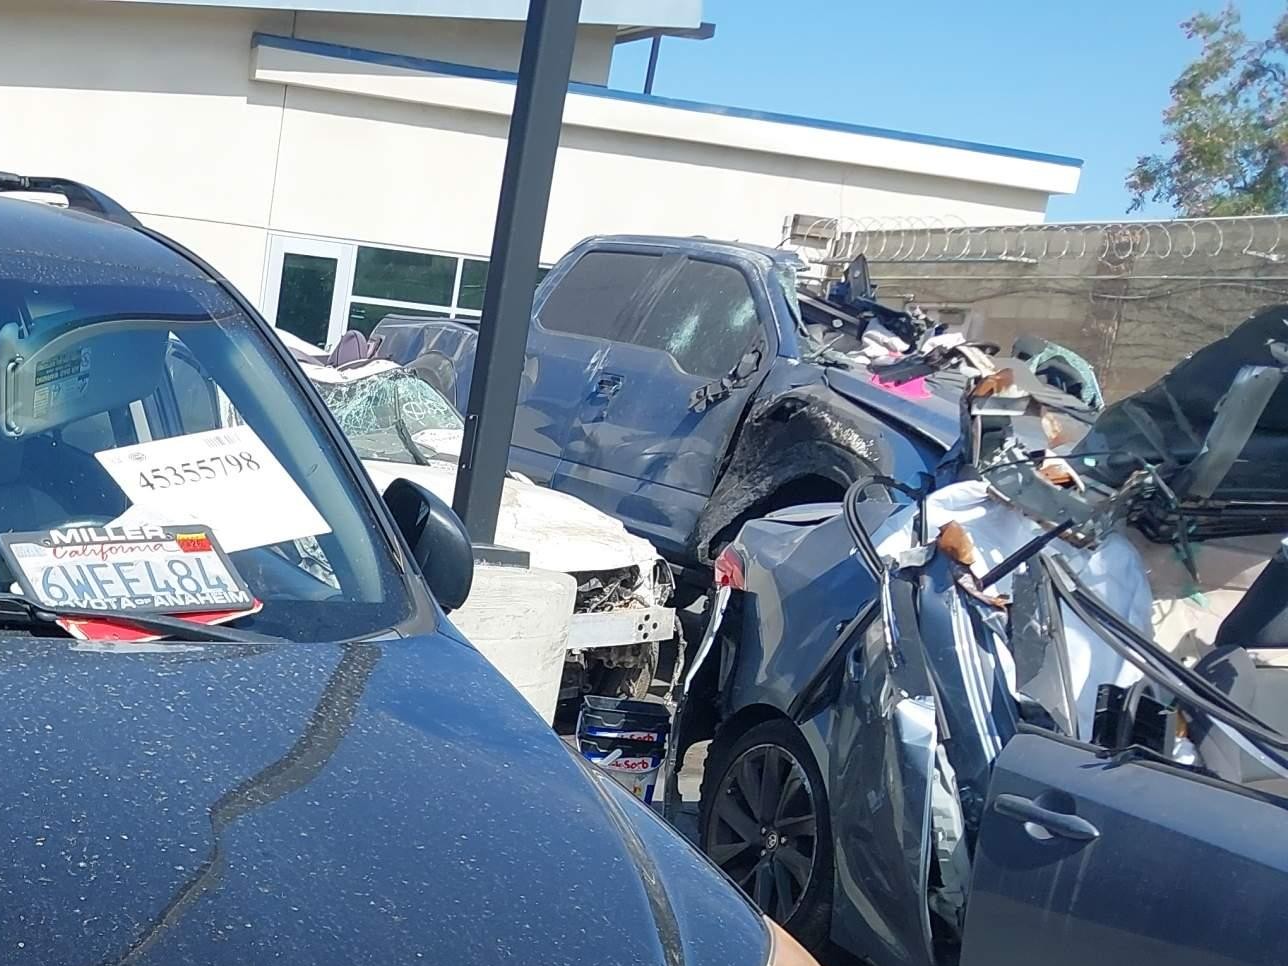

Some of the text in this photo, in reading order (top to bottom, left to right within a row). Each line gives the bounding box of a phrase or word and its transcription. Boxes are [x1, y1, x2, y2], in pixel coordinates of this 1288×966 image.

[139, 451, 261, 490] 45355798
[49, 526, 167, 545] MILLER
[52, 541, 177, 561] California
[153, 590, 251, 608] ANAHEIM
